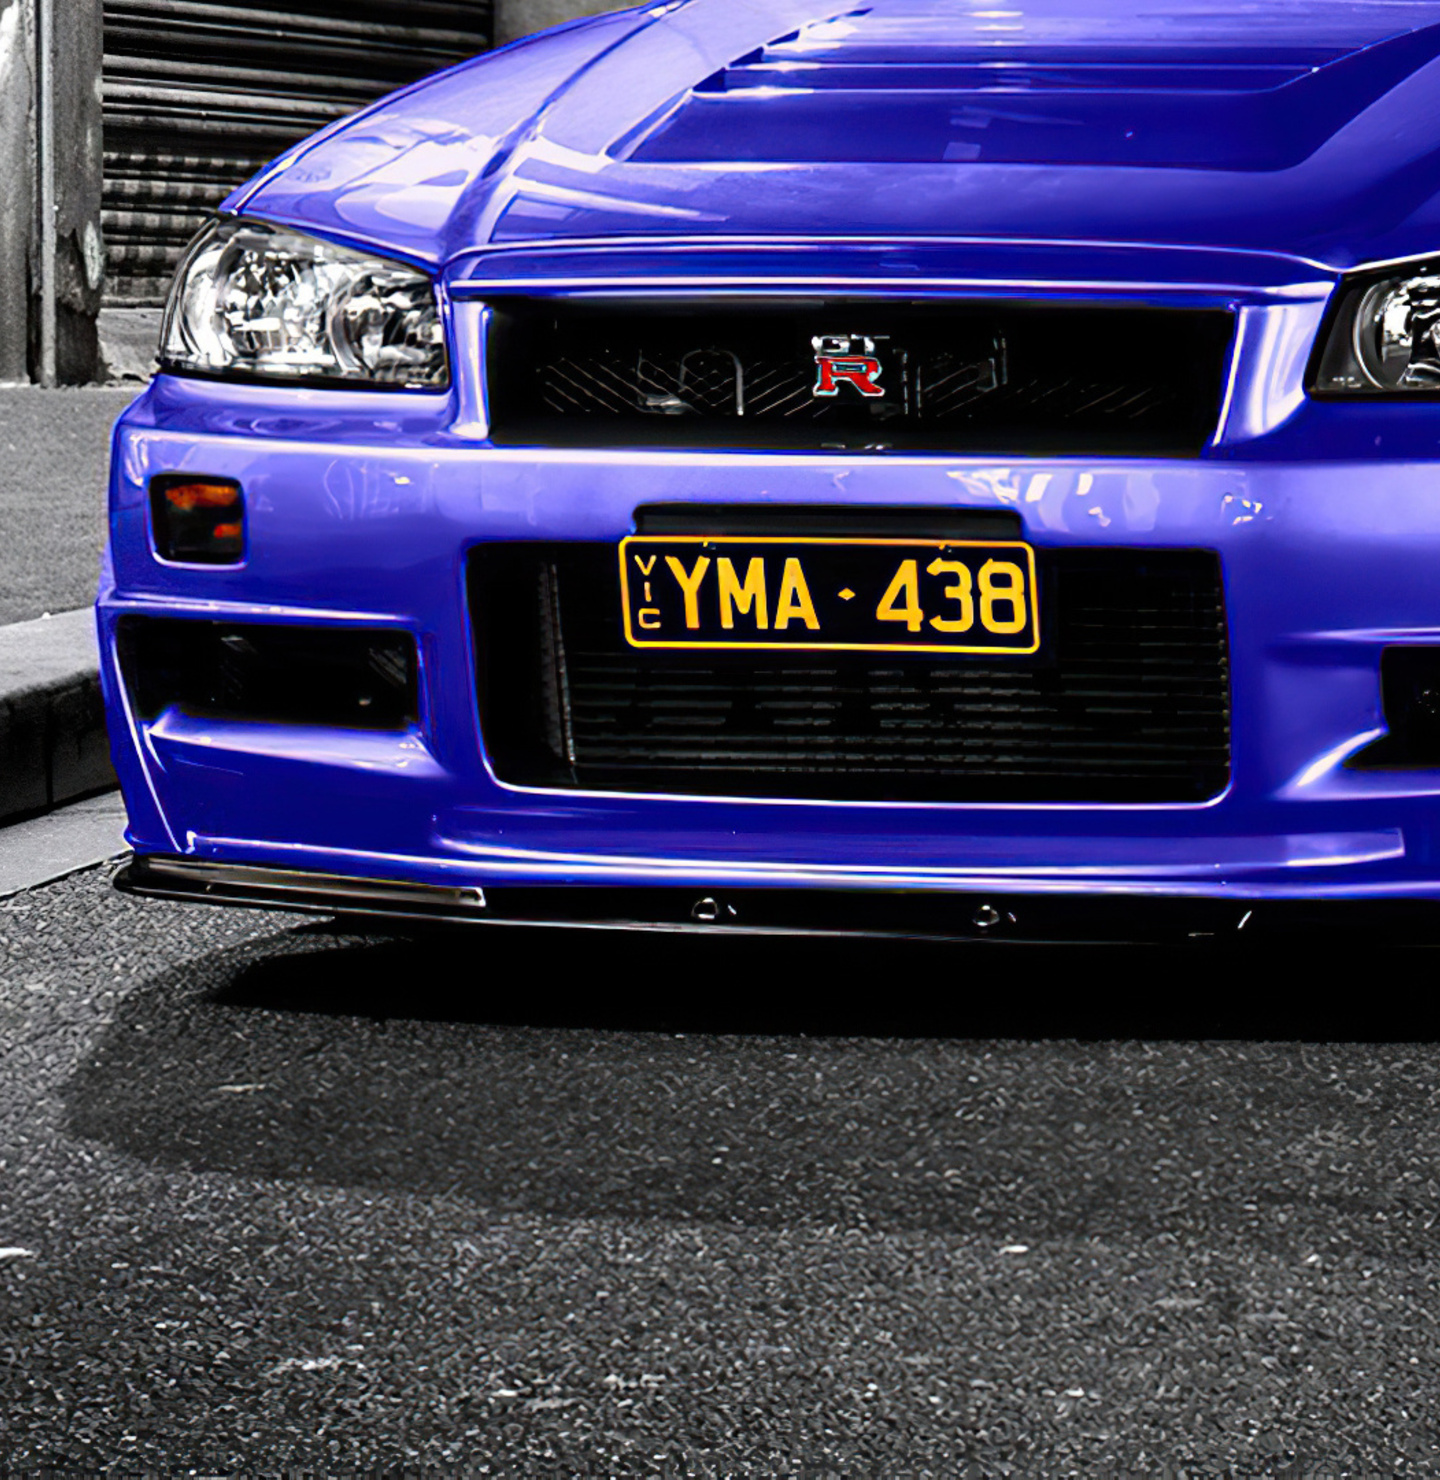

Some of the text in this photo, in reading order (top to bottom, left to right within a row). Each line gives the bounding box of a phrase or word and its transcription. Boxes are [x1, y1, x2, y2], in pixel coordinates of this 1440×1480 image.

[813, 355, 887, 398] R
[634, 554, 661, 629] VIC
[665, 556, 1028, 634] YMA 438
